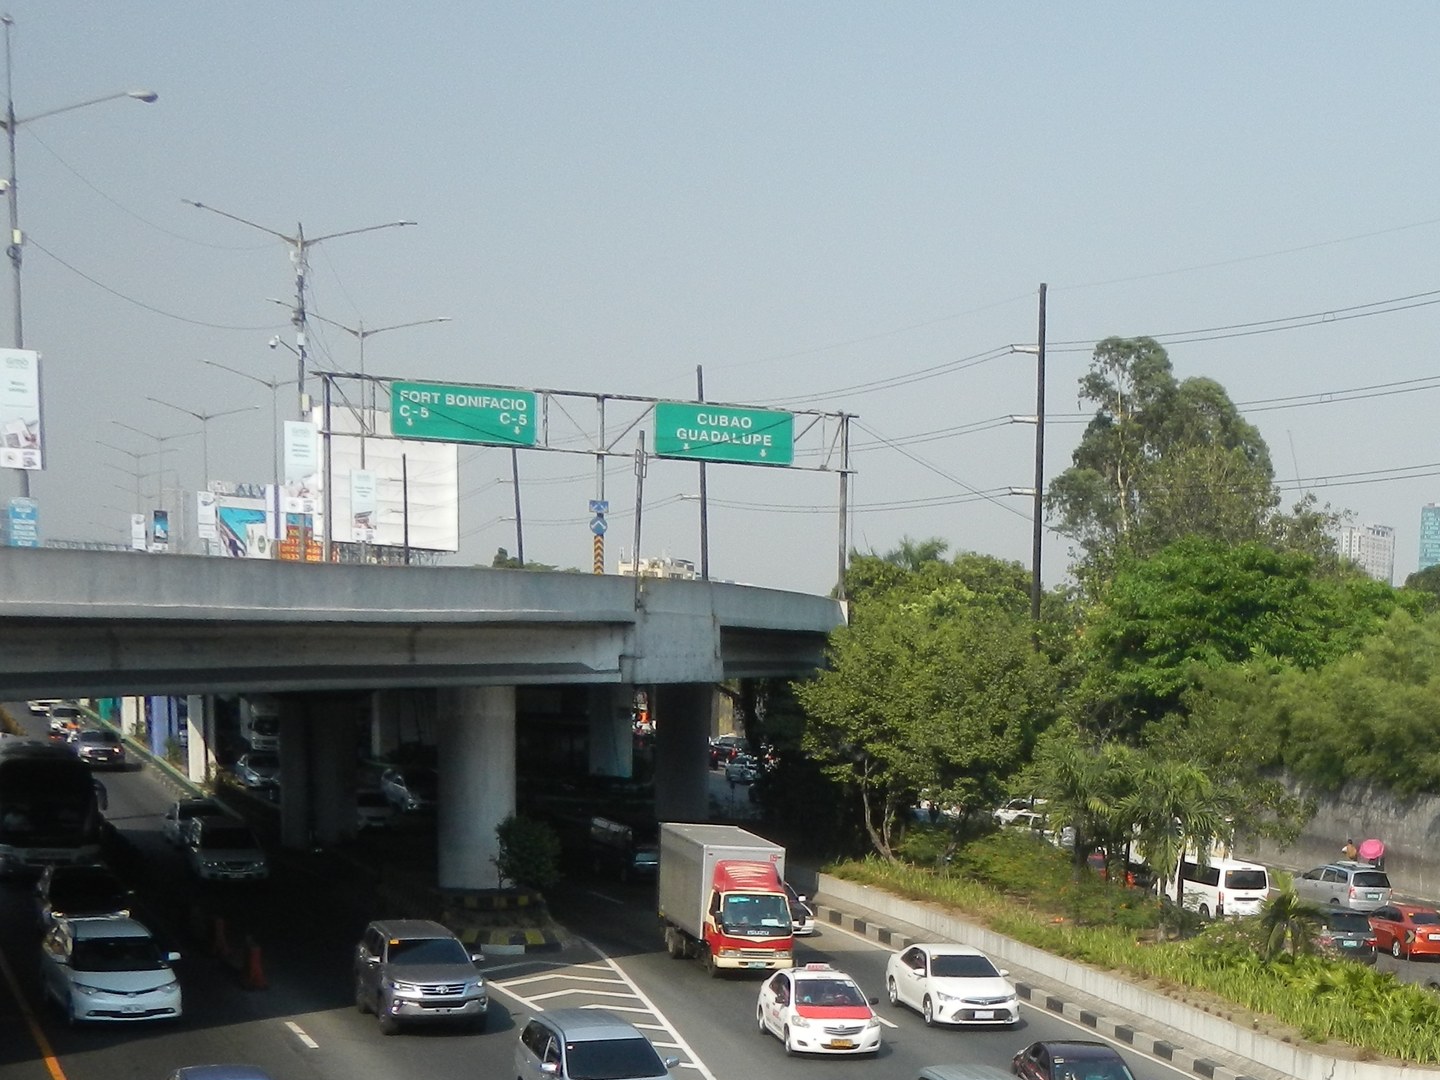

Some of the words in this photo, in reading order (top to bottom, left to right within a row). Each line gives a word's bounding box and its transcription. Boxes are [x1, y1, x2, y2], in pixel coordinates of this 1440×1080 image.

[401, 390, 440, 404] FORT
[445, 394, 526, 411] BONIFACIO
[399, 405, 429, 418] C-5
[500, 413, 527, 425] C-5
[697, 413, 752, 428] CUBAO
[676, 428, 772, 446] GUADALUPE
